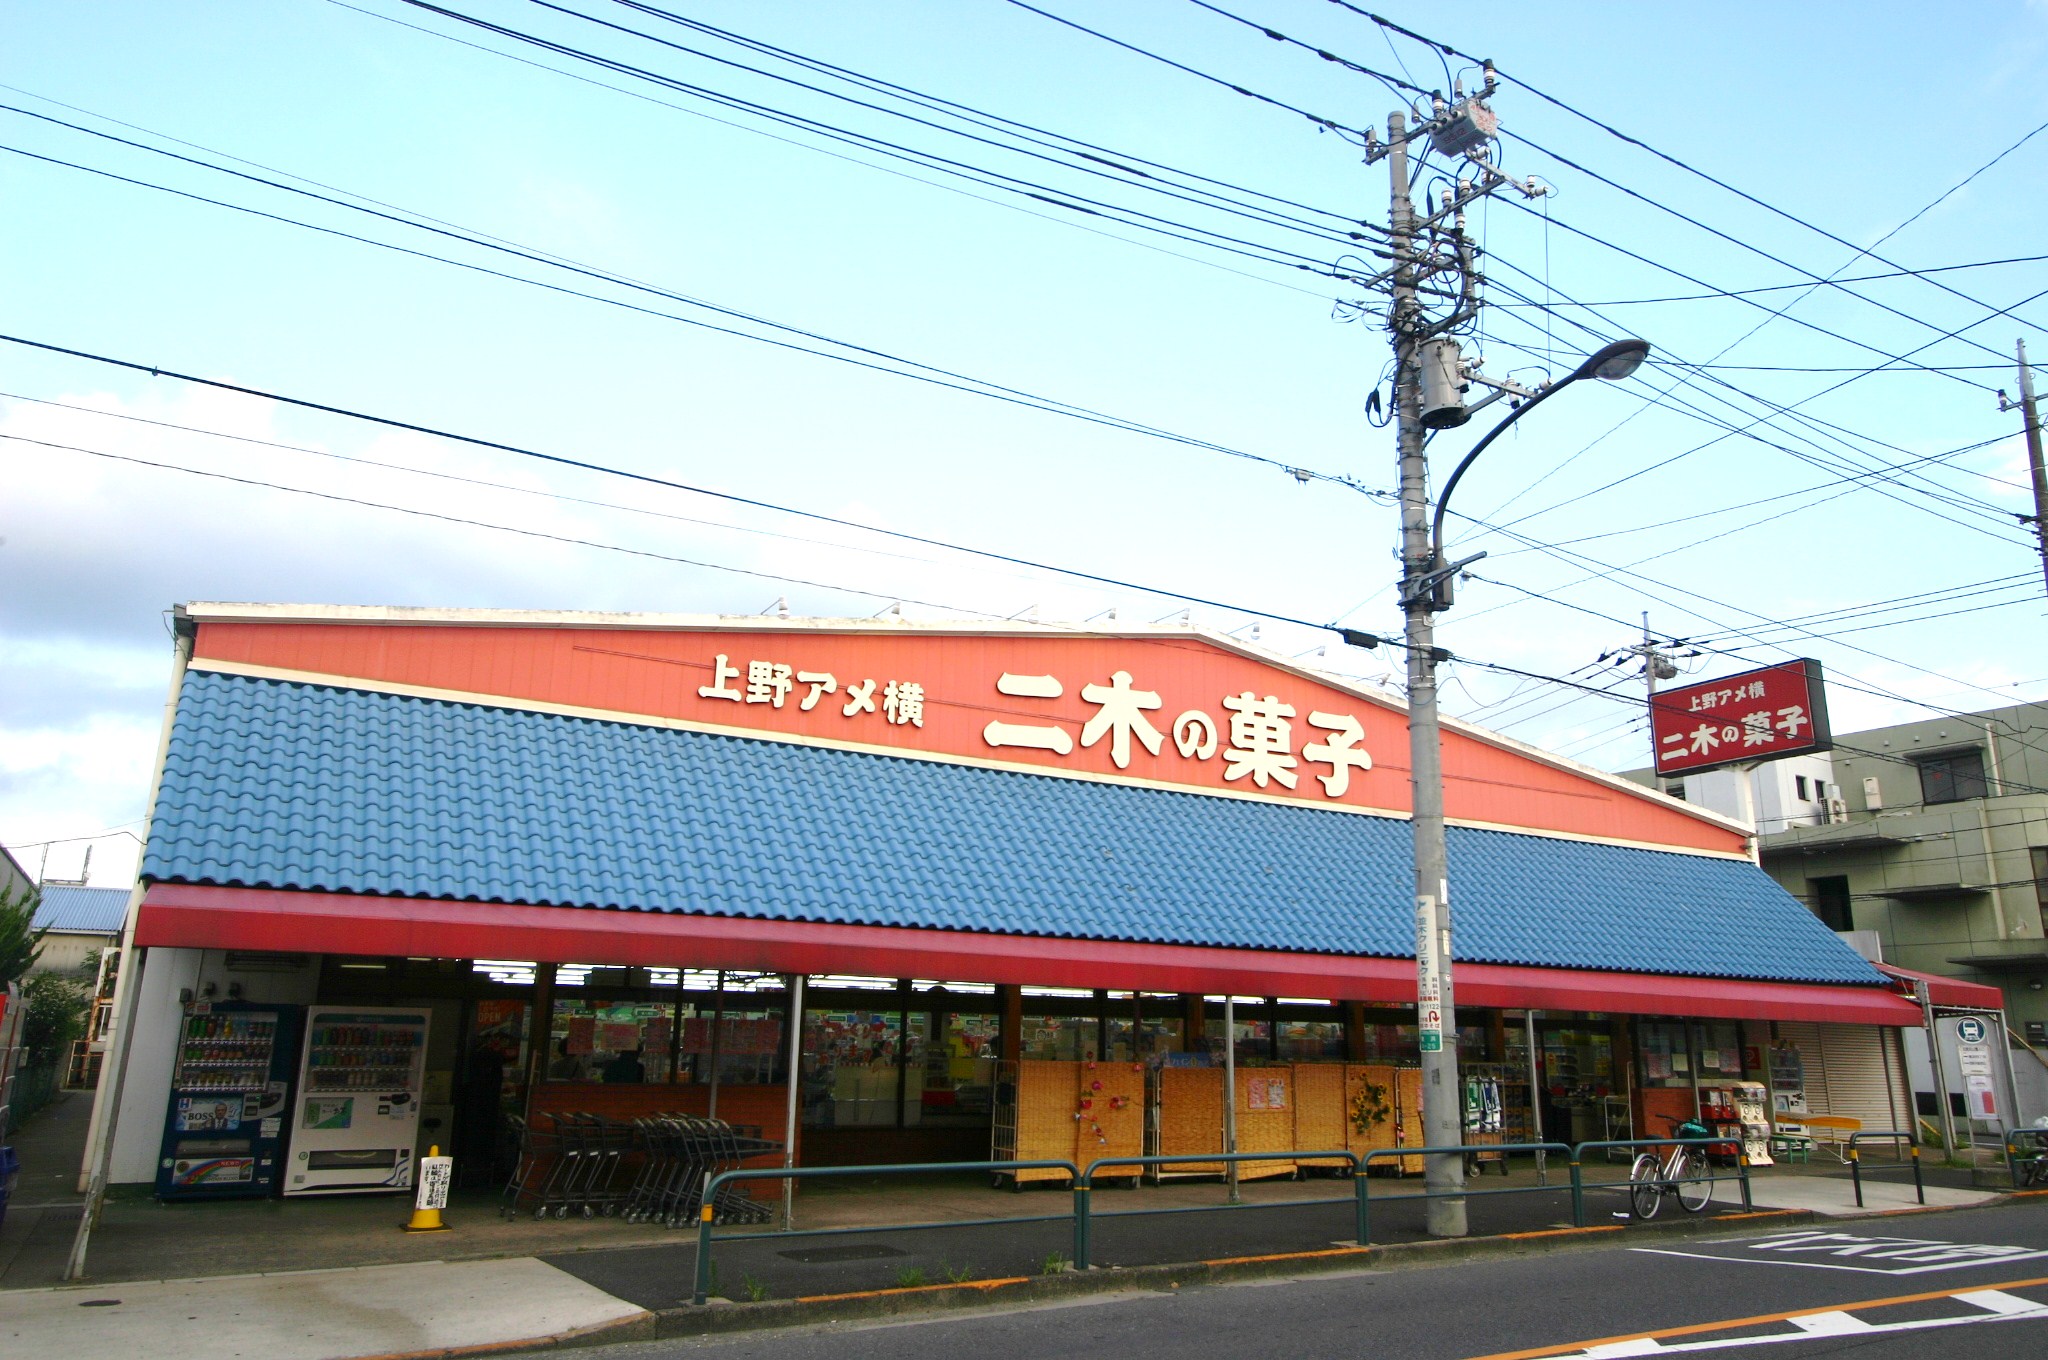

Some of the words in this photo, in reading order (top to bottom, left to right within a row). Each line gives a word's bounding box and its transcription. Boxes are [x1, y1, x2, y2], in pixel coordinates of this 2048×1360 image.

[1689, 681, 1766, 712] 上野アメ横
[698, 654, 925, 729] 上野アメ横
[983, 670, 1372, 798] 二木の菓子
[1661, 705, 1808, 761] 二木の菓子
[188, 1112, 214, 1121] BOSS
